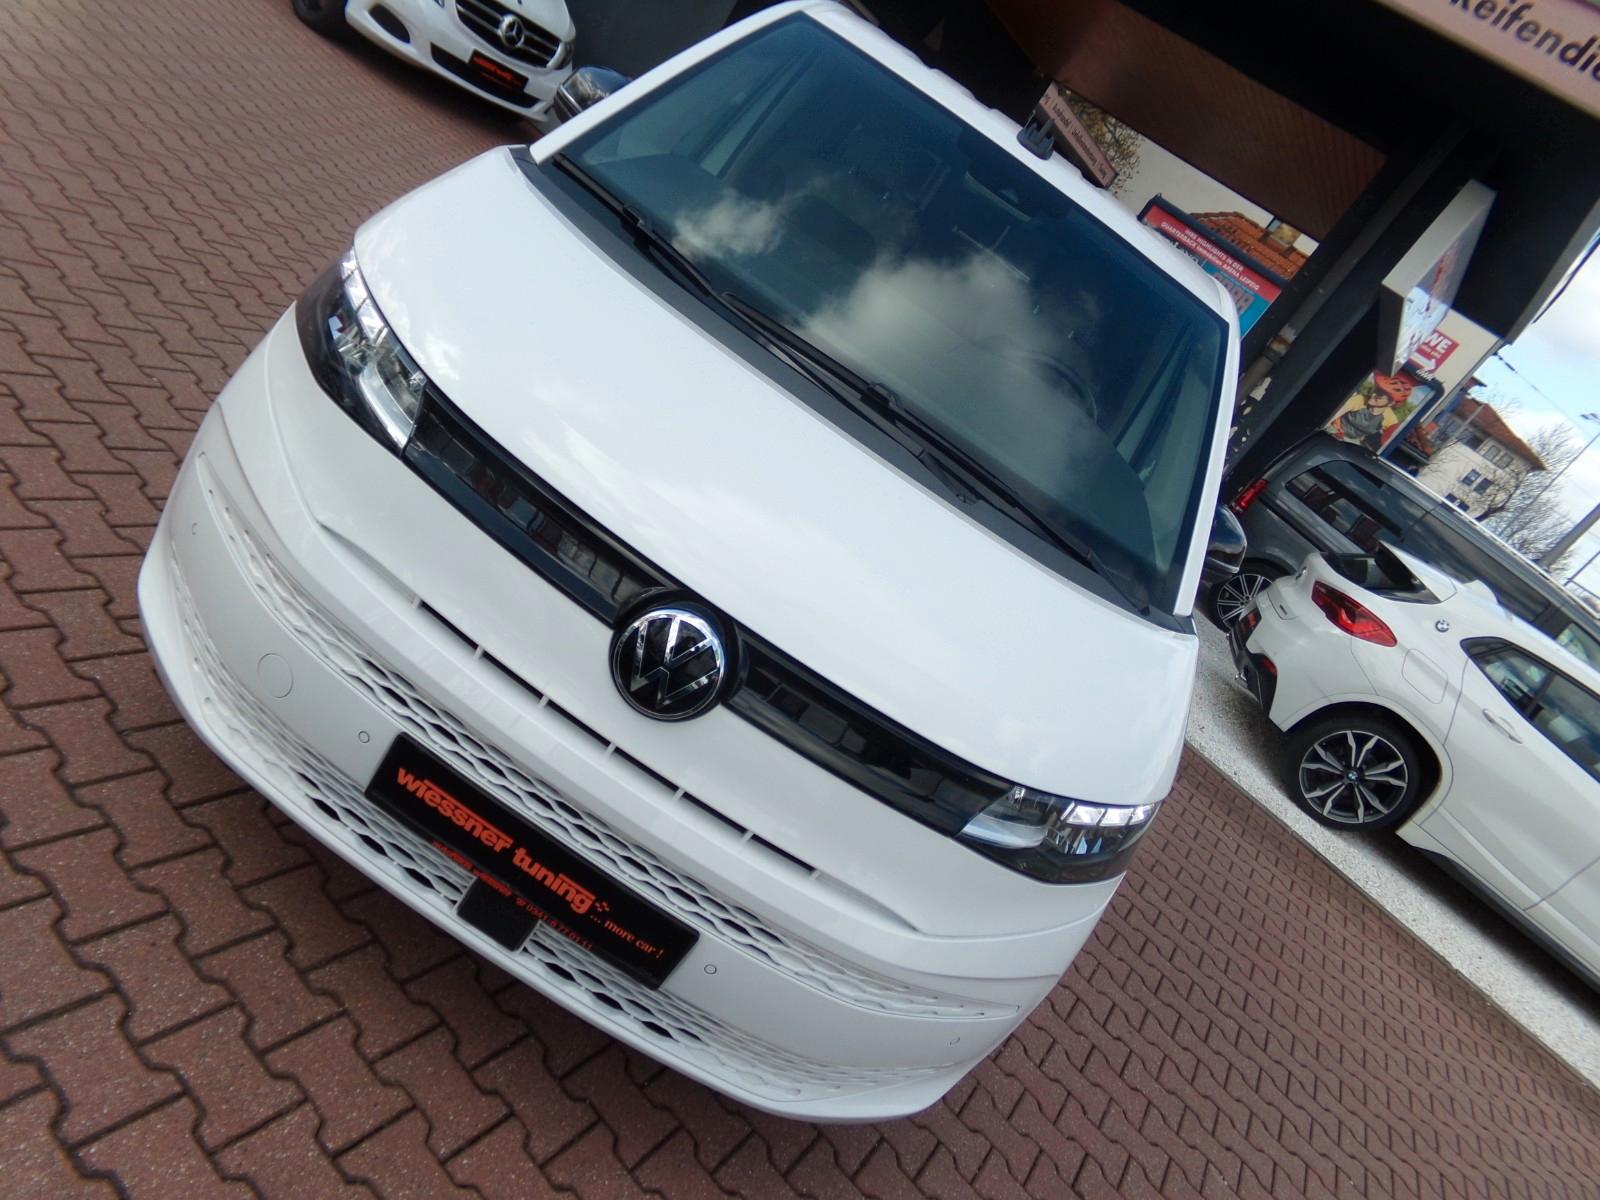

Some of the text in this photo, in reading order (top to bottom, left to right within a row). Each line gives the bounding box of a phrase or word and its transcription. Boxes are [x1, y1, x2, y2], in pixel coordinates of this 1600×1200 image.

[1198, 236, 1227, 260] HIGHLIGHTS
[1239, 274, 1260, 291] LEIPZIG
[396, 767, 514, 852] wiessner
[512, 847, 597, 915] tuning
[604, 919, 636, 943] more
